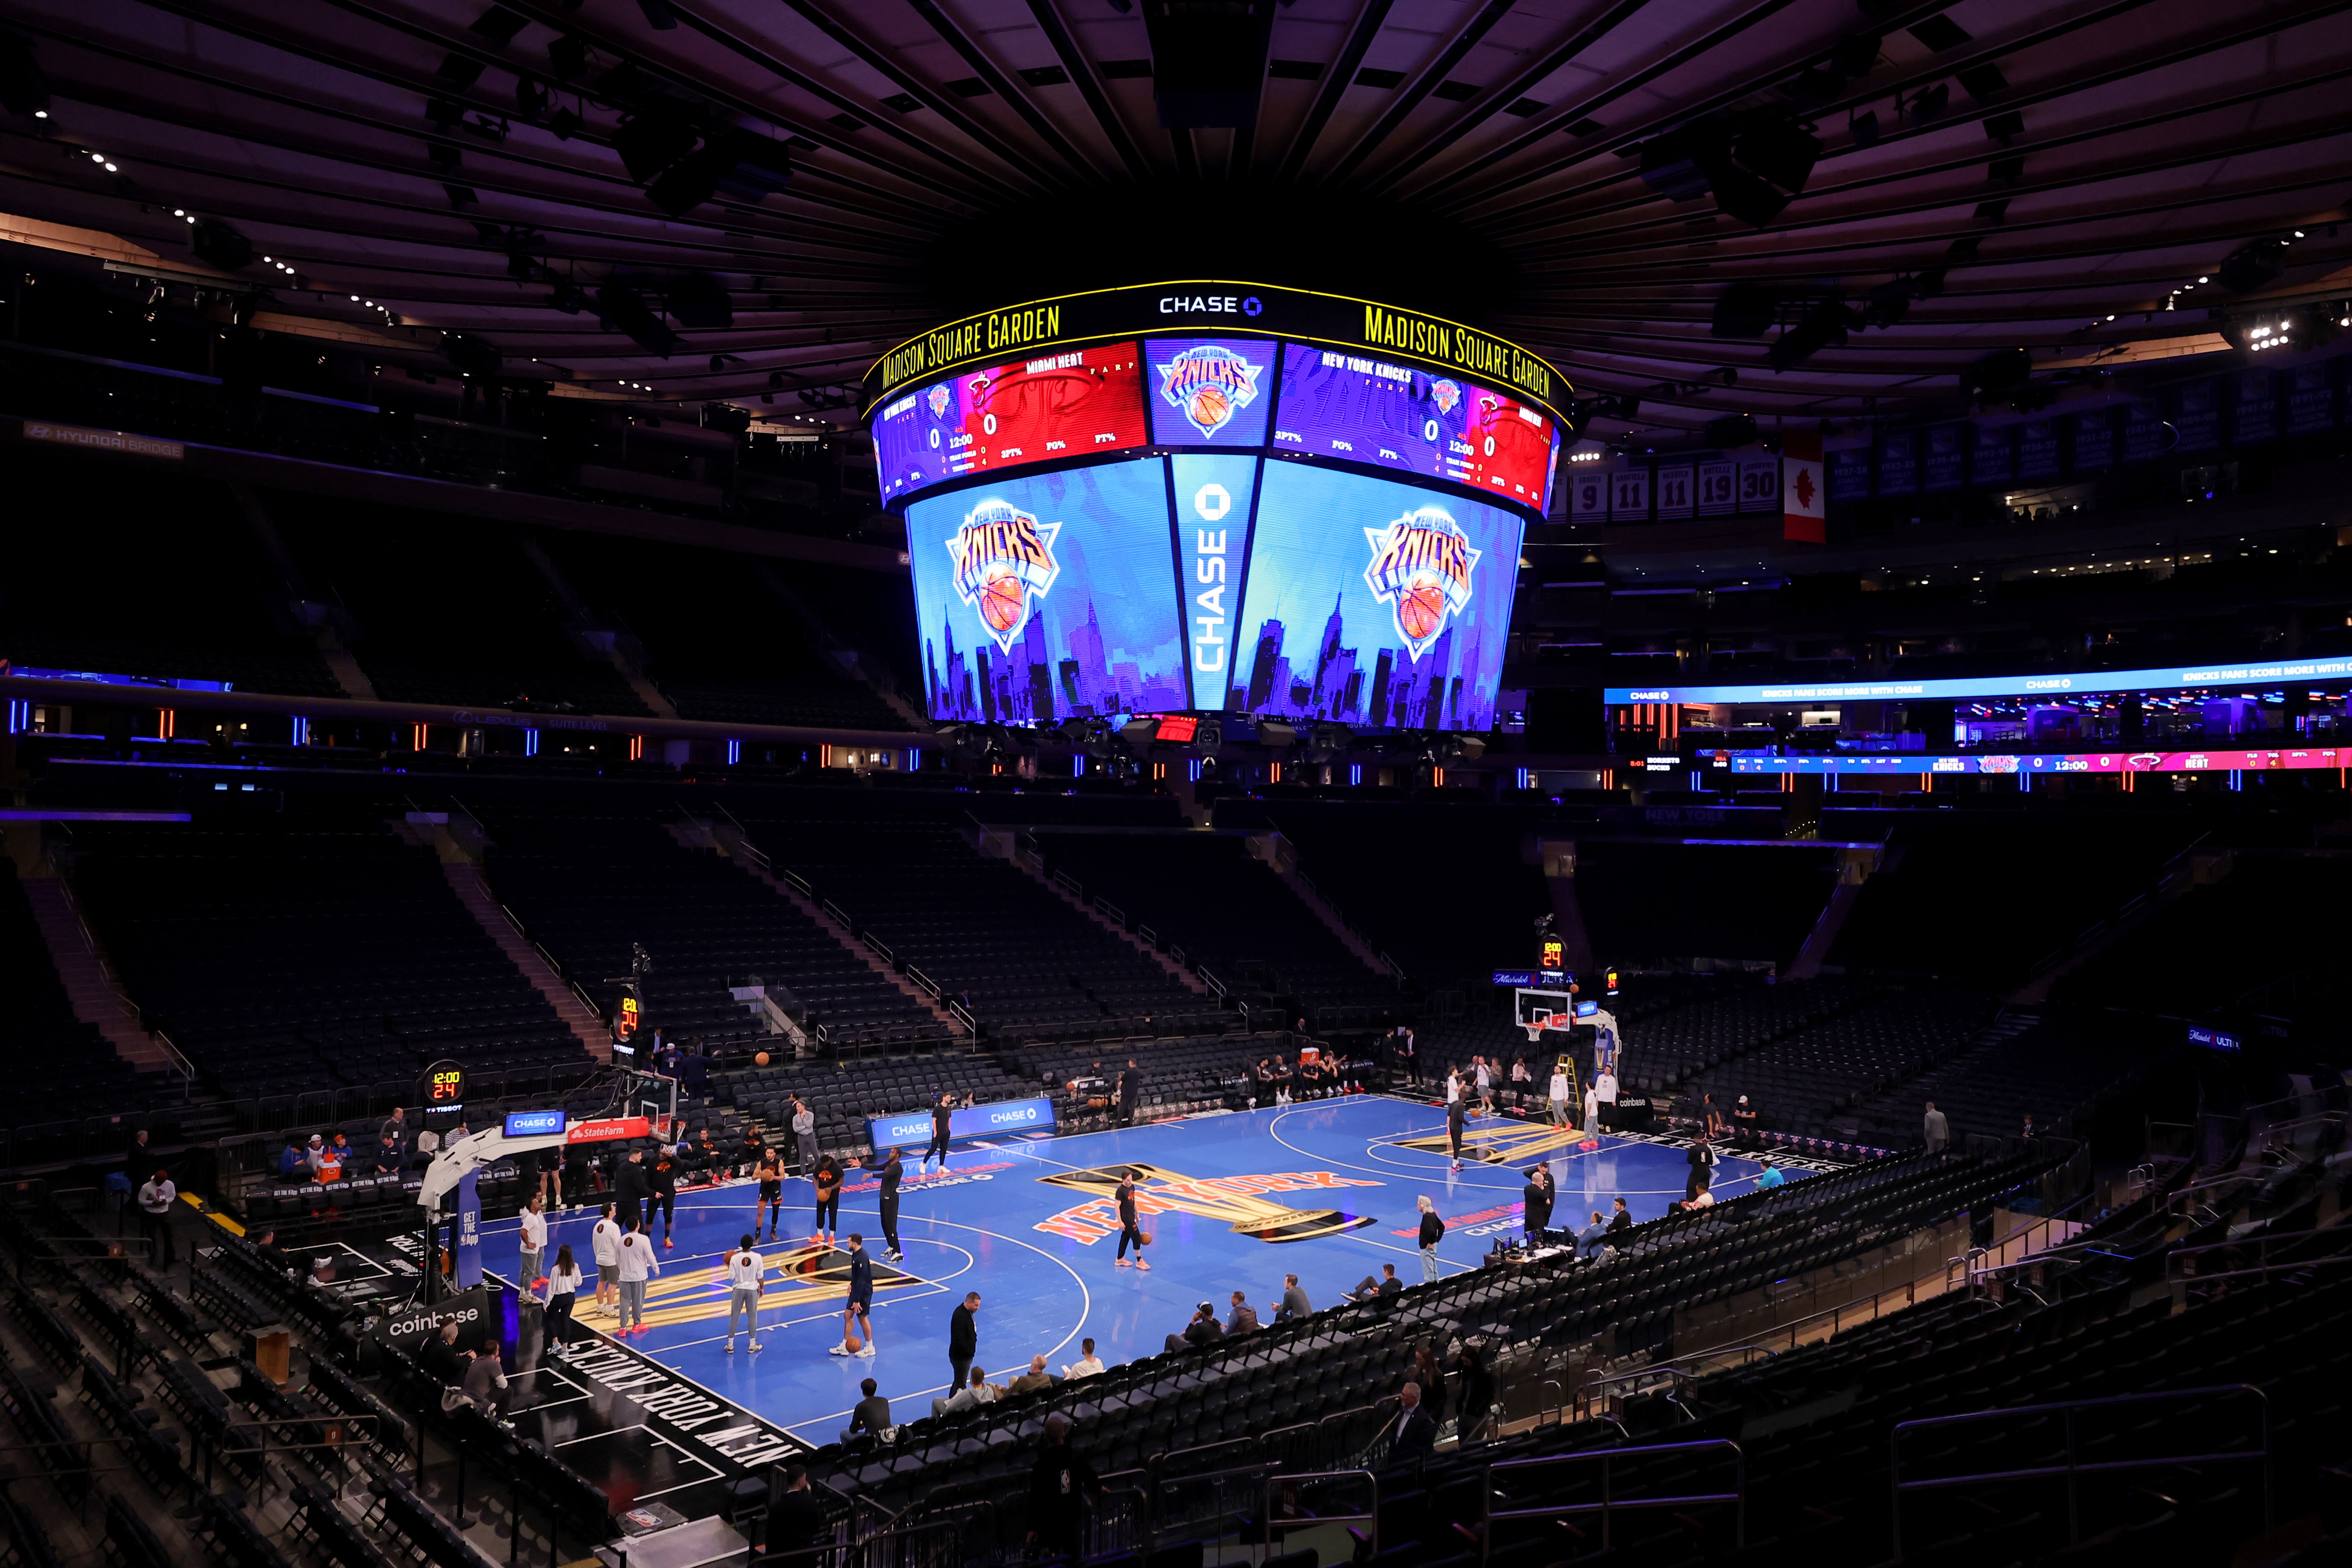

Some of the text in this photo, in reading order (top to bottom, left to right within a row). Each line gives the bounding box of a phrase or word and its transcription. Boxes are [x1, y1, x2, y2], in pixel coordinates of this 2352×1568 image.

[1160, 297, 1238, 313] CHASE
[883, 305, 1059, 390] MADISON SQUARE GARDEN
[1192, 350, 1228, 359] NEW YORK
[1365, 305, 1550, 399] MADISON SQUARE GARDEN
[1026, 352, 1083, 375] MIAMI HEAT
[1322, 352, 1412, 383] NEW YORK KNICKS
[1165, 358, 1253, 394] KNICKS
[899, 395, 916, 411] KNICKS
[983, 414, 997, 435] 0
[1425, 419, 1439, 441] 0
[56, 429, 180, 457] HYUNDAI BRIDGE
[930, 429, 940, 449] 0
[949, 434, 973, 449] 12:00
[1457, 432, 1467, 441] 4th
[1001, 433, 1116, 459] 3PT% FG% FT%
[1275, 431, 1398, 460] 3PT% FG% FT%
[1449, 441, 1474, 456] 12:00
[1484, 436, 1495, 457] 0
[949, 453, 962, 462] TEAM
[1446, 457, 1460, 467] TEAM
[1460, 460, 1474, 470] FOULS
[1664, 480, 1686, 507] 11
[1703, 475, 1731, 503] 19
[1743, 471, 1775, 500] 30
[1582, 485, 1597, 510] 9
[1619, 483, 1642, 509] 11
[974, 506, 1013, 523] NEW YORK
[1414, 515, 1454, 534] NEW YORK
[957, 517, 1053, 582] KNICKS
[1371, 523, 1469, 592] KNICKS
[1196, 529, 1227, 672] CHASE
[2183, 671, 2220, 682] KNICKS
[2221, 670, 2248, 679] FANS
[2249, 668, 2282, 677] SCORE
[2284, 665, 2315, 676] MORE
[2316, 663, 2345, 673] WITH
[1762, 685, 1923, 698] KNICKS FANS SCORE MORE WITH CHASE
[2026, 680, 2060, 689] CHASE
[1630, 692, 1659, 700] CHASE
[475, 715, 608, 731] LEXUS SUITE LEVEL
[1933, 762, 1964, 771] KNICKS
[2034, 757, 2042, 767] 0
[2055, 761, 2088, 771] 12:00
[2100, 756, 2110, 767] 0
[2185, 759, 2209, 769] HEAT
[1646, 808, 1726, 822] NEW YORK
[1545, 942, 1561, 951] 12:00
[1543, 950, 1561, 966] 24
[1493, 974, 1528, 984] Michelob
[1608, 980, 1616, 988] 24
[621, 1011, 637, 1035] 24
[619, 1045, 634, 1055] TISSOT
[433, 1071, 460, 1084] 12:00
[434, 1083, 455, 1099] 24
[436, 1105, 462, 1113] TISSOT
[1620, 1097, 1646, 1107] coinbase
[514, 1119, 546, 1128] CHASE
[991, 1110, 1026, 1123] CHASE
[892, 1122, 930, 1137] CHASE
[896, 1177, 974, 1194] CHASE
[1033, 1171, 1388, 1246] NEW YORK
[463, 1211, 476, 1223] GET
[463, 1222, 476, 1233] THE
[466, 1233, 480, 1246] App
[557, 1339, 803, 1468] NEW YORK KNICKS
